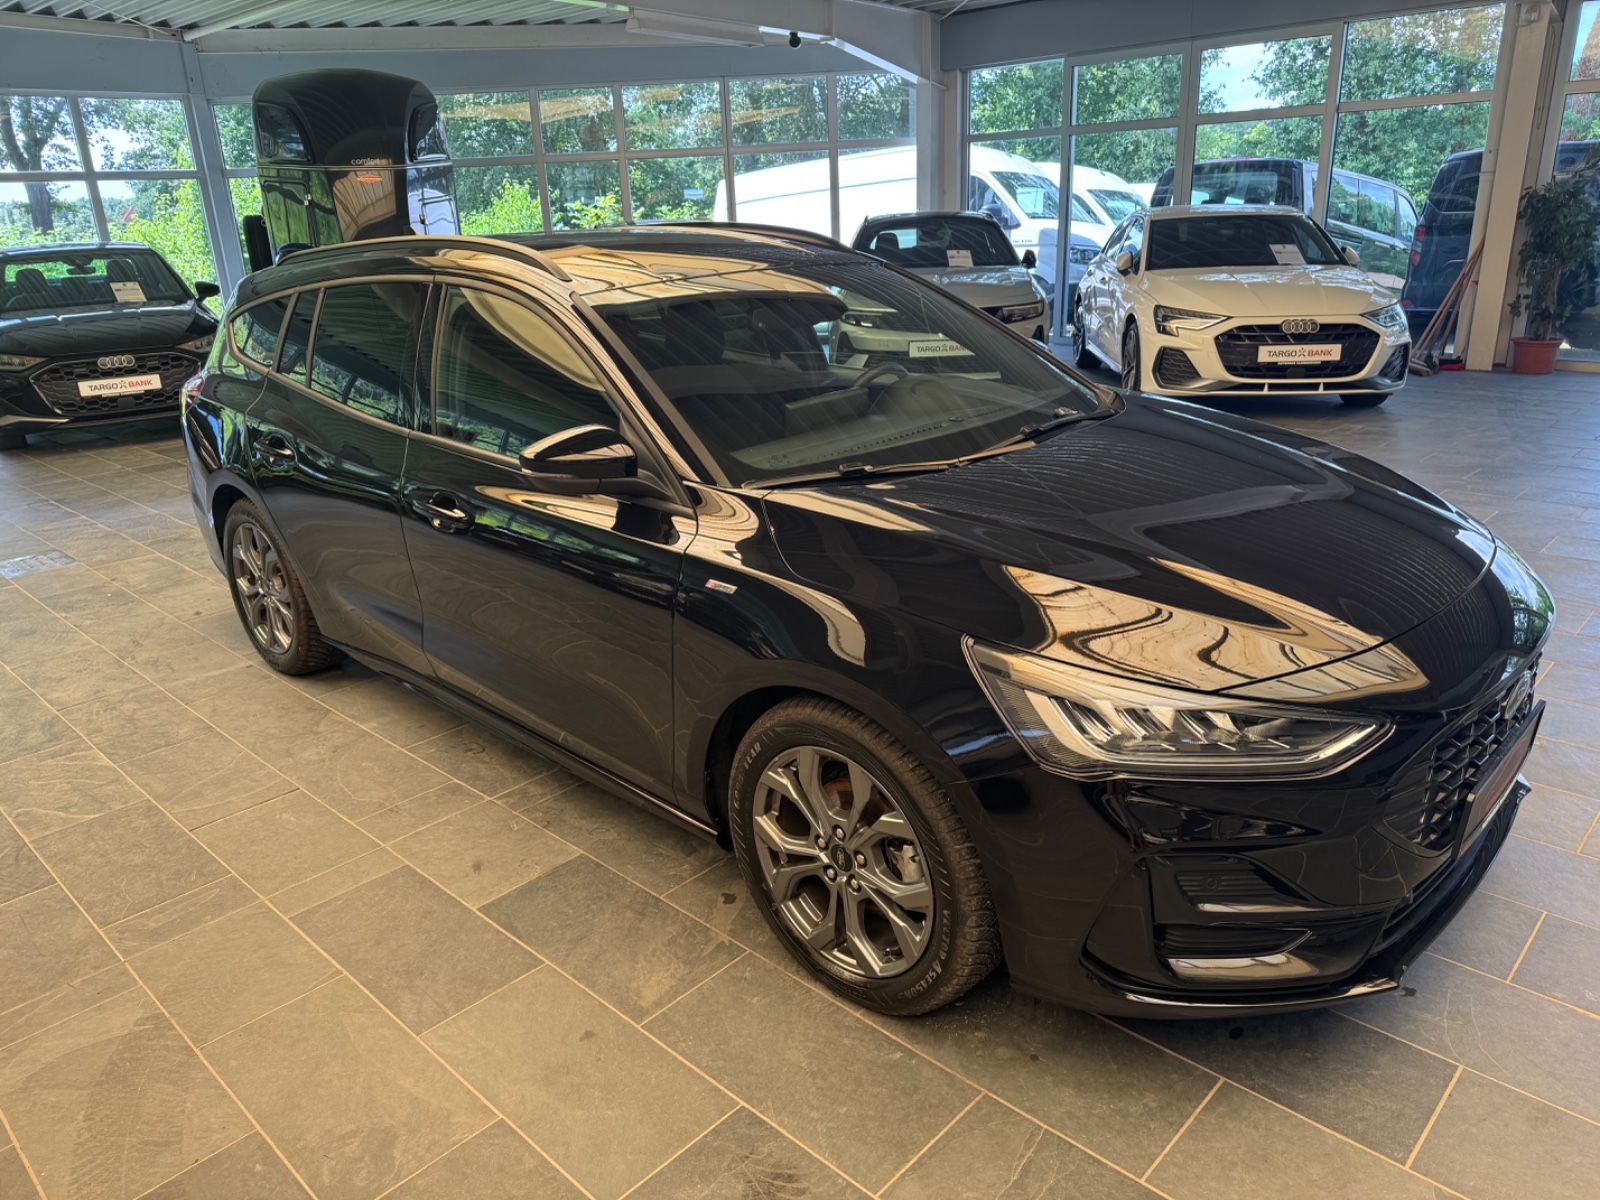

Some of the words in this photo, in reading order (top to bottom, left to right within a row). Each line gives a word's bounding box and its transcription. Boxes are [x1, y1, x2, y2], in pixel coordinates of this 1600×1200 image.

[1267, 350, 1297, 358] TARGO
[1307, 349, 1333, 357] BANK
[88, 382, 119, 392] TARGO
[128, 379, 153, 388] BANK
